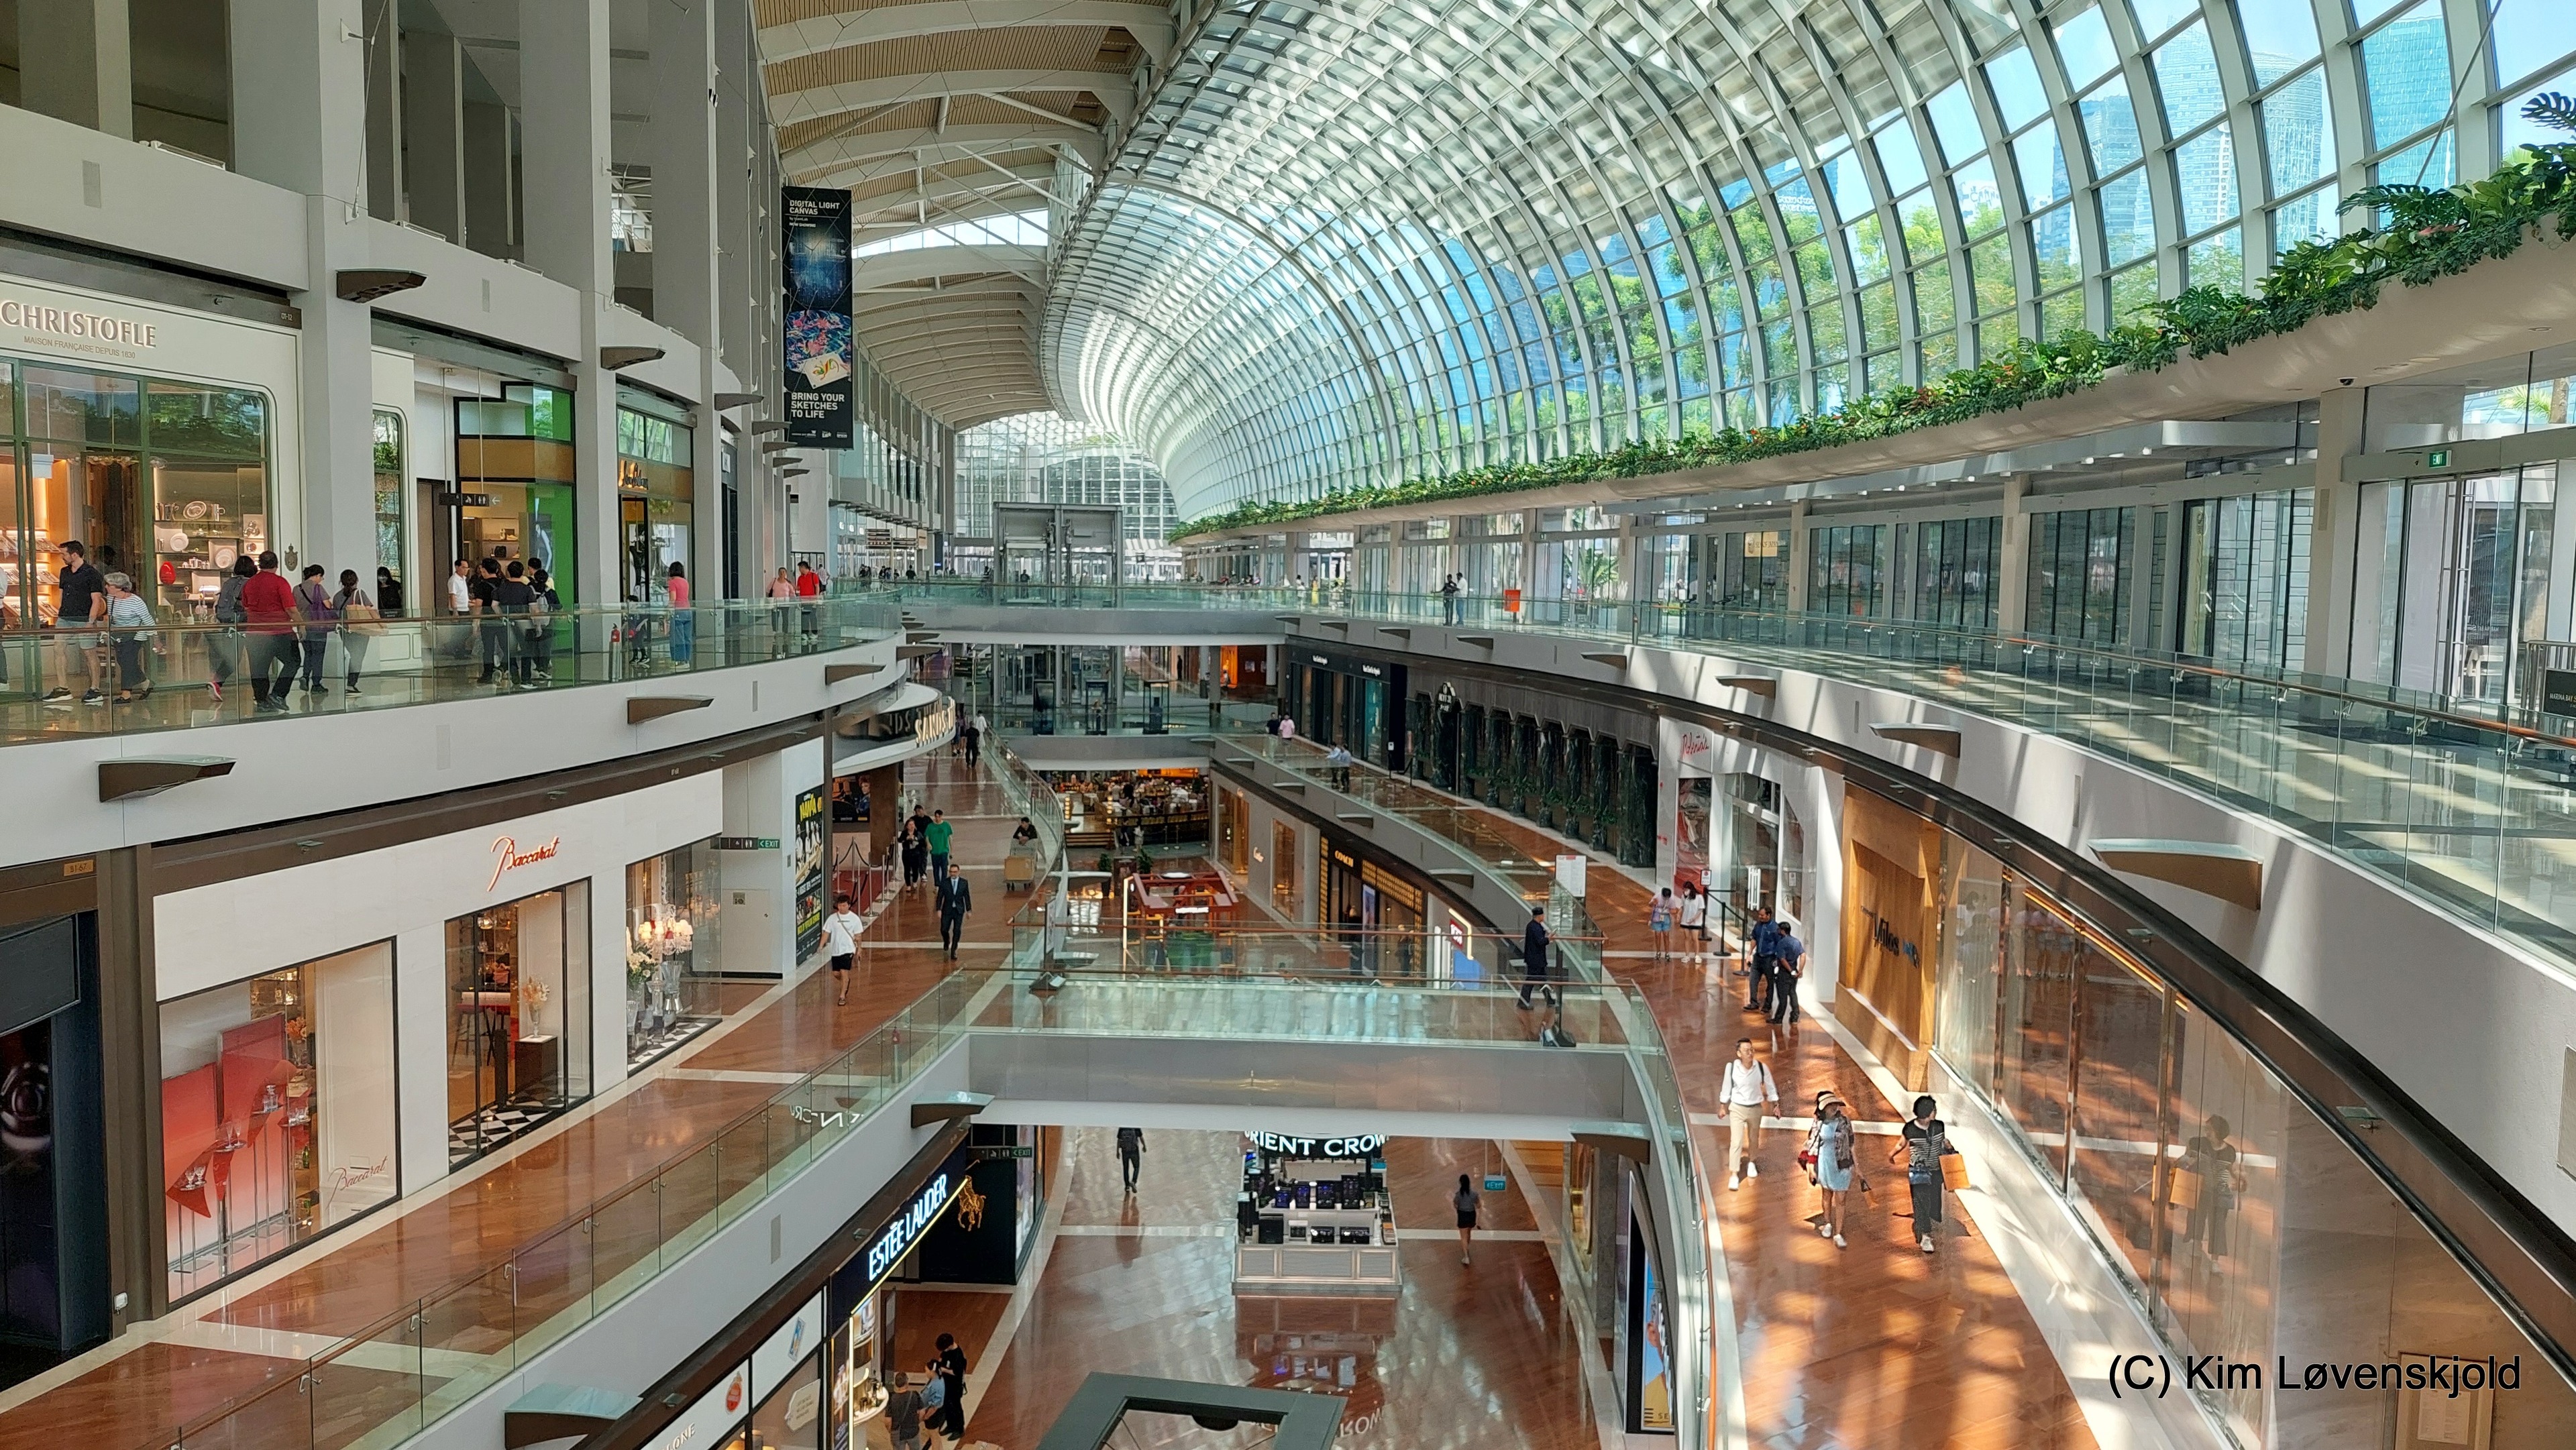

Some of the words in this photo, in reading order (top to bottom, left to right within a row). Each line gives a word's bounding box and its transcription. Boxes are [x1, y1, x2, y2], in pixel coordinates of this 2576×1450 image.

[790, 200, 818, 208] DIGITAL
[1, 301, 156, 347] CHRISTOFLE
[24, 335, 53, 347] MAISON
[54, 340, 94, 353] FRANÇAISE
[95, 347, 120, 356] DEPUIS
[121, 350, 136, 359] 1830
[791, 401, 838, 410] SKETCHES
[792, 392, 819, 401] BRING
[820, 393, 845, 402] YOUR
[792, 410, 804, 418] TO
[805, 410, 825, 419] LIFE
[2432, 453, 2443, 465] EXIT
[914, 710, 947, 744] SANDS
[765, 840, 779, 848] EXIT
[487, 836, 560, 892] Baccarat
[1324, 1133, 1389, 1156] CROW
[325, 1156, 388, 1211] Baccarat
[906, 1174, 947, 1241] LAUDER
